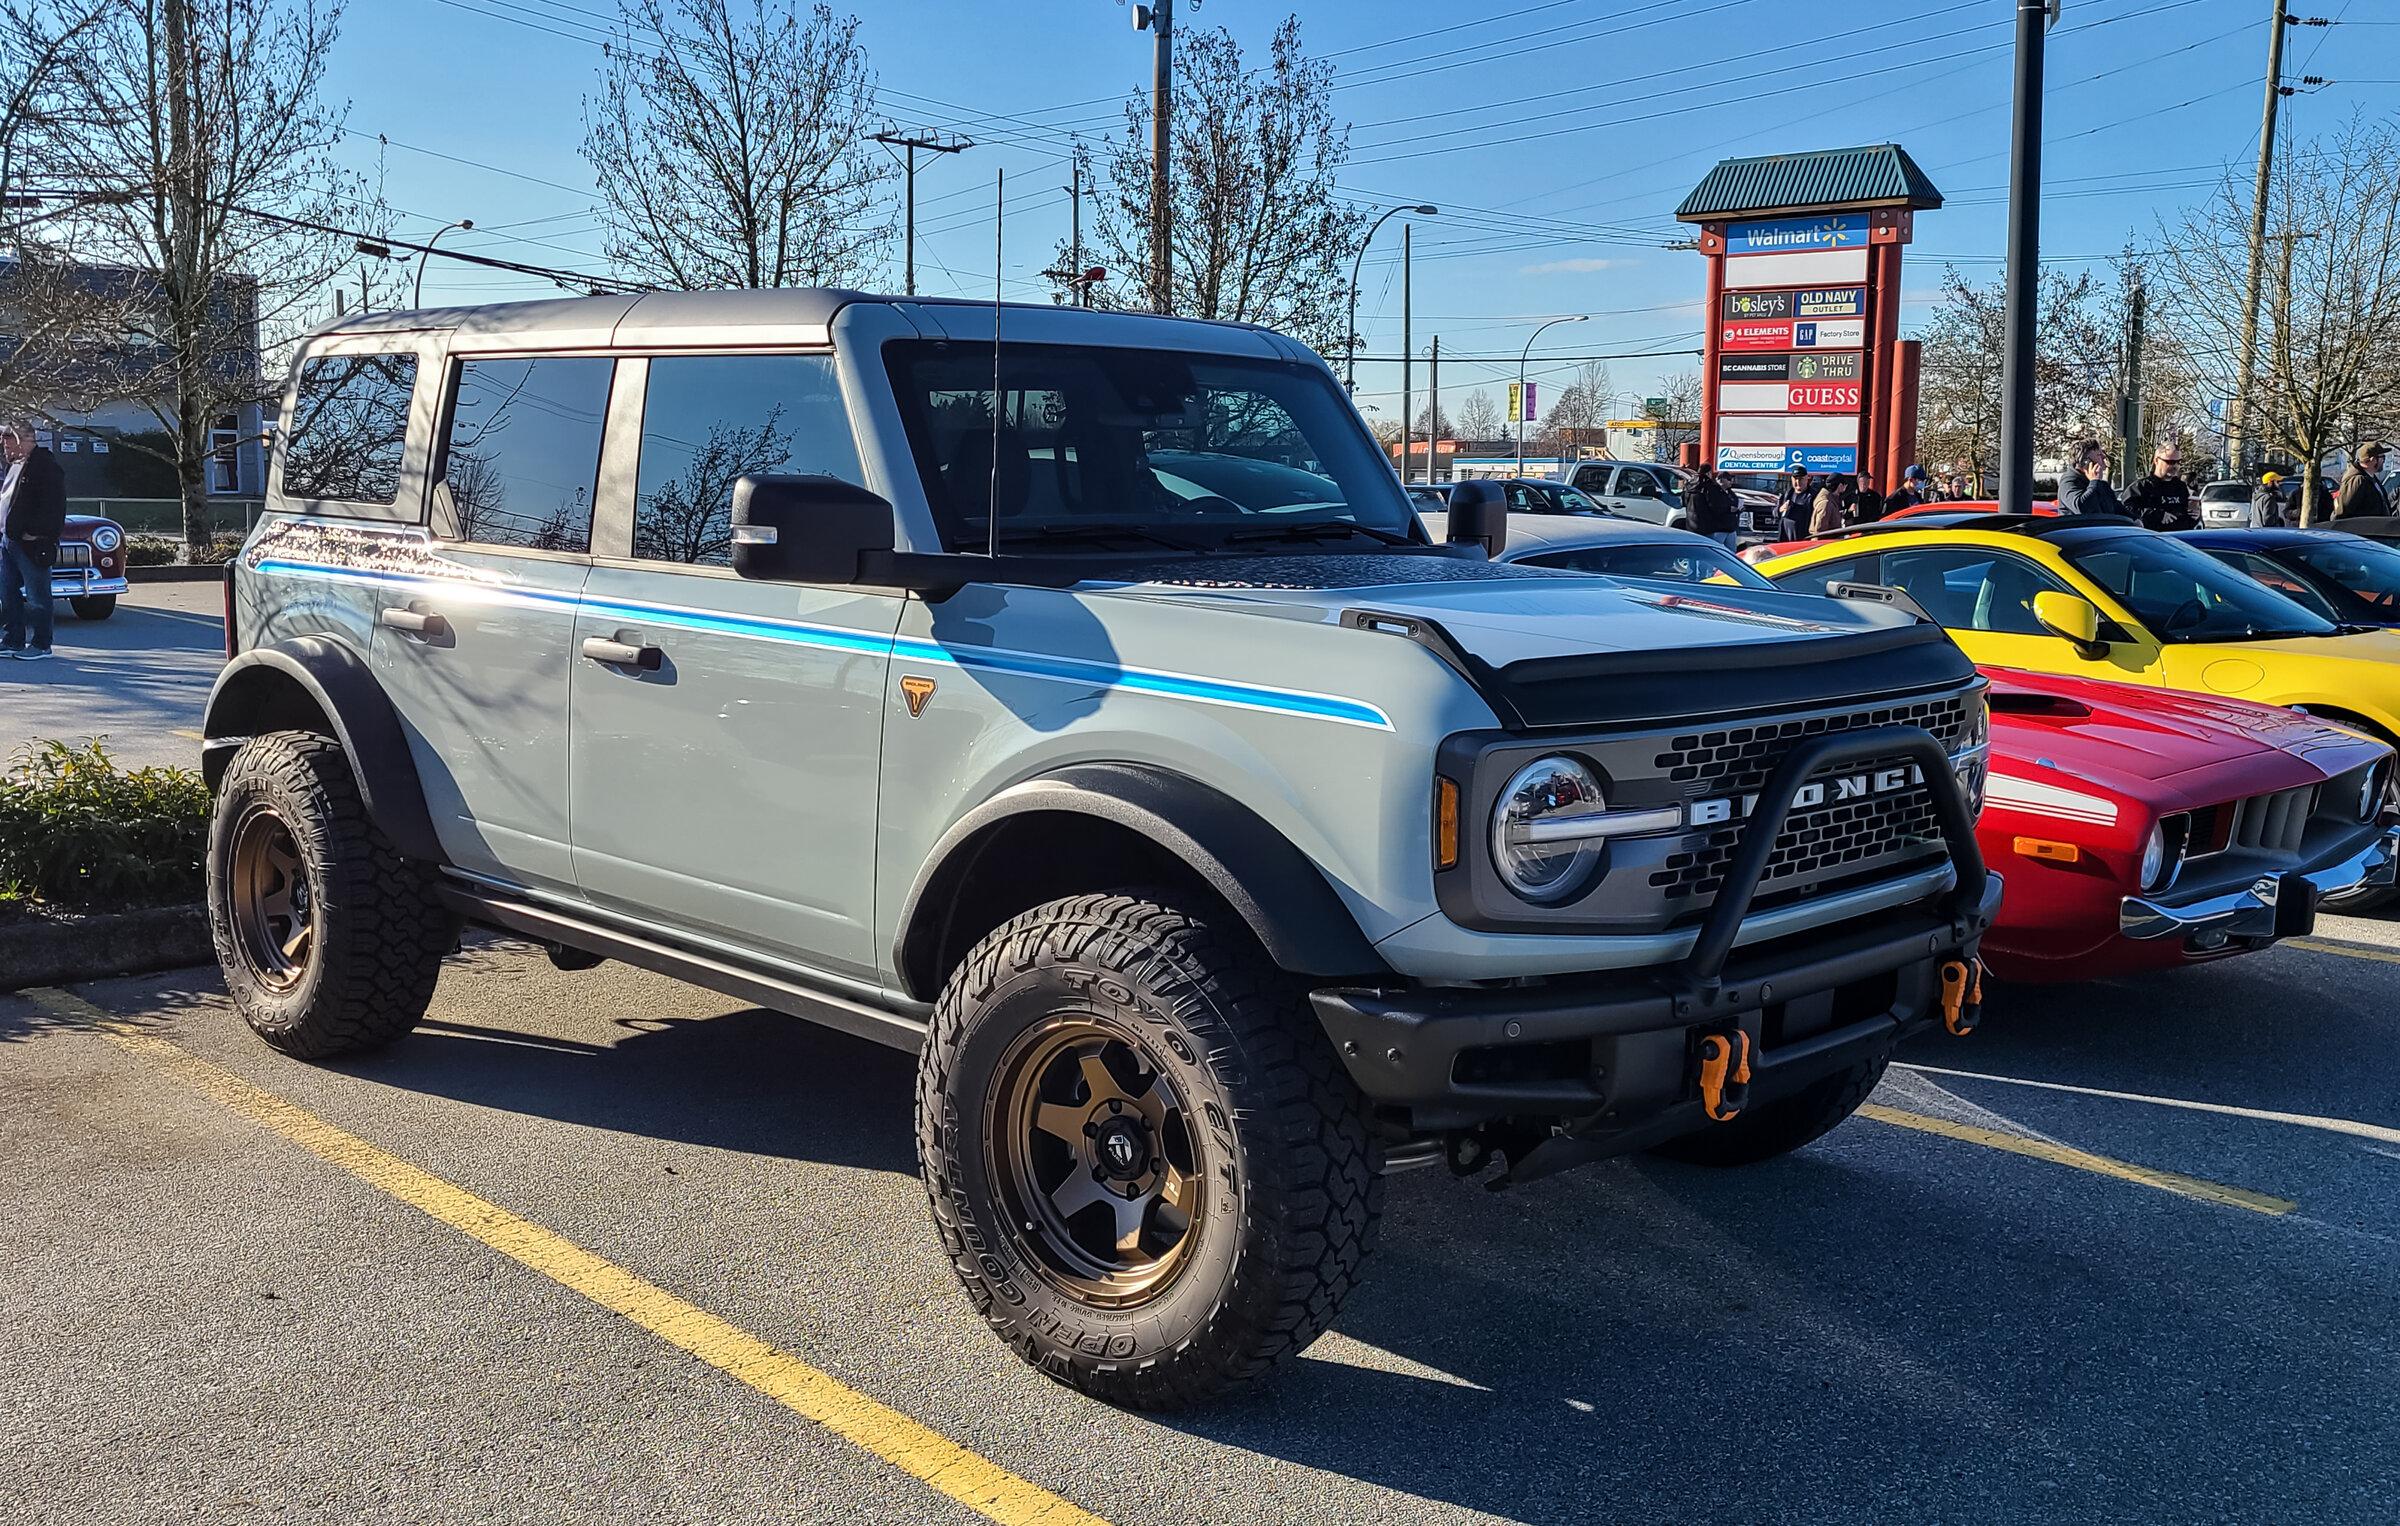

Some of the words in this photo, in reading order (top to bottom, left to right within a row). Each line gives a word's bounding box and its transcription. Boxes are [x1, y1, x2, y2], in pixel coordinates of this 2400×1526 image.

[1747, 225, 1820, 247] Walmart
[1801, 292, 1823, 304] OLD
[1825, 290, 1857, 303] NAVY
[1731, 295, 1785, 317] bosley's
[1812, 305, 1843, 313] OUTLET
[1743, 327, 1789, 336] ELEMENTS
[1800, 329, 1813, 341] GAP
[1820, 331, 1842, 339] Factory
[1822, 355, 1854, 366] DRIVE
[1822, 367, 1852, 377] THRU
[1790, 388, 1859, 405] GUESS
[1730, 449, 1784, 460] Queensborough
[1807, 454, 1852, 464] coastcapital
[1062, 968, 1197, 1066] TOYO
[943, 1089, 1027, 1306] COUNTRY
[1025, 1306, 1137, 1358] OPEN
